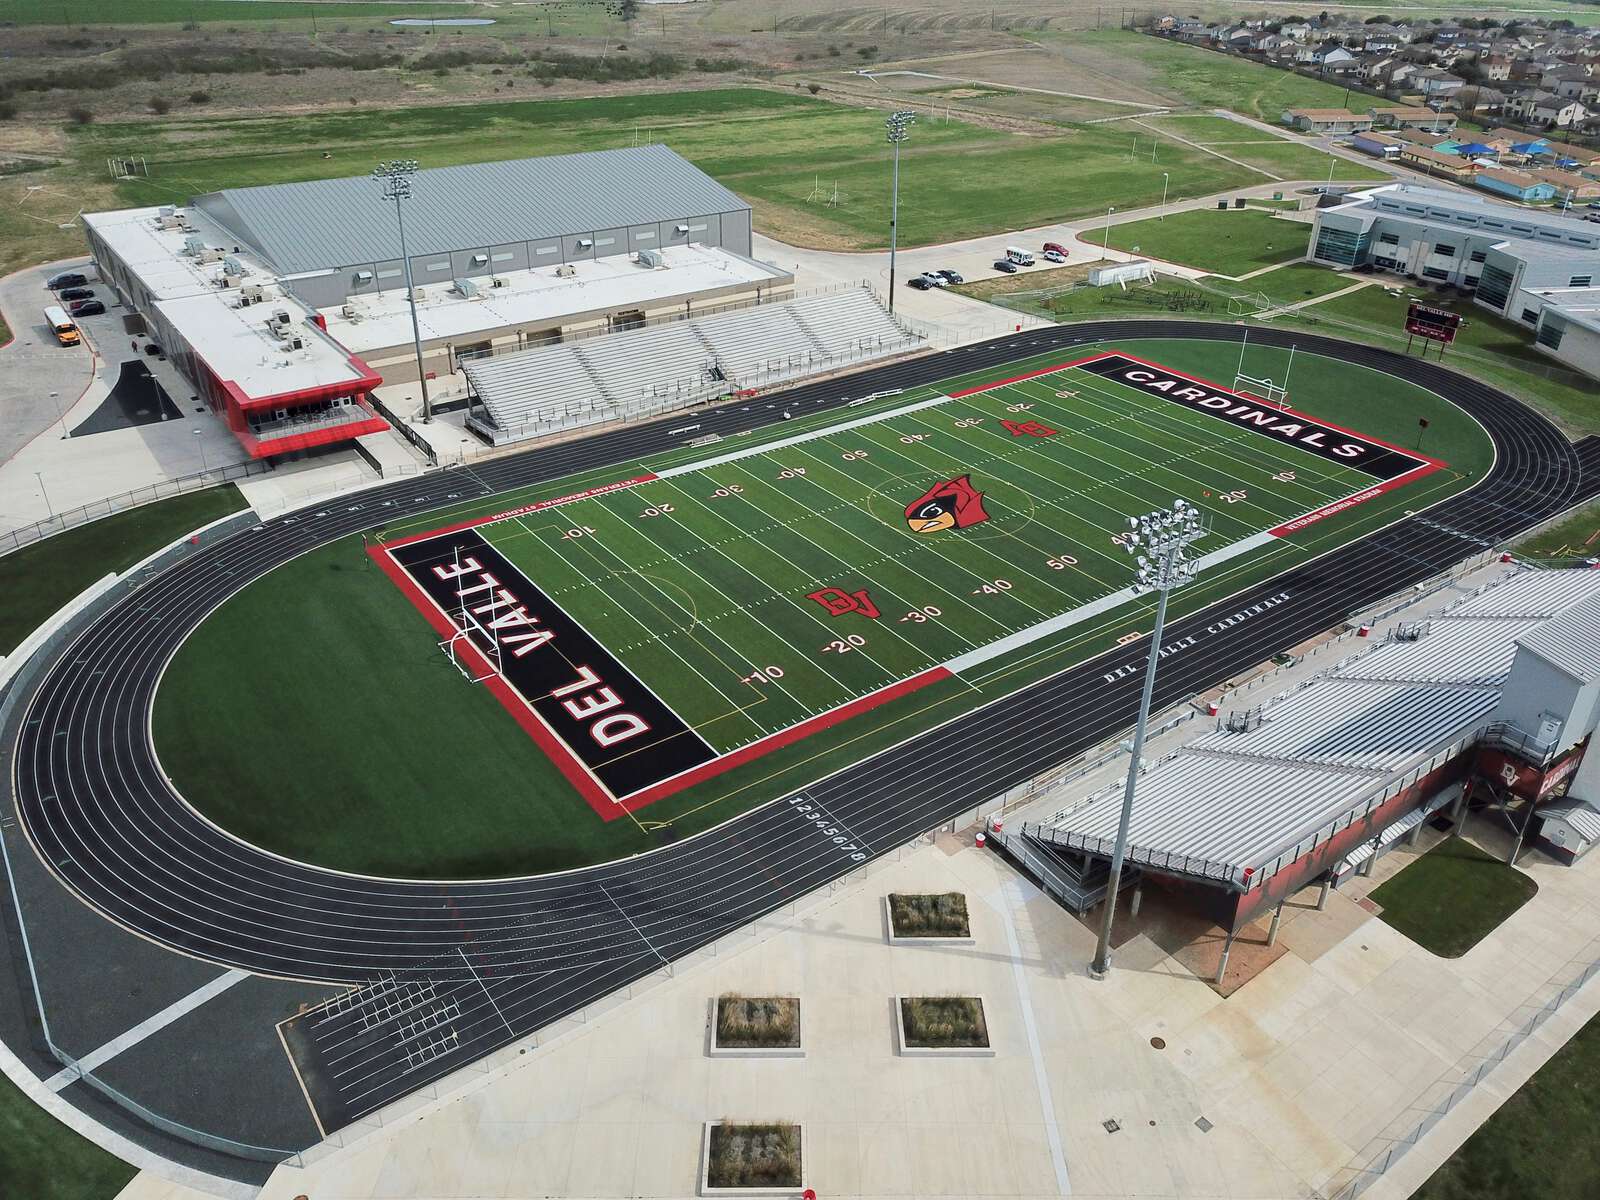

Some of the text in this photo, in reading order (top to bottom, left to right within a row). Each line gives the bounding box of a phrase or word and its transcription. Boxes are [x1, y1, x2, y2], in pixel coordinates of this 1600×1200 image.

[1006, 403, 1030, 413] 20
[1125, 370, 1366, 458] CARDINALS
[954, 418, 980, 428] 30
[900, 434, 924, 444] 40
[842, 450, 869, 461] 50
[780, 466, 807, 479] 40
[1272, 472, 1296, 483] 10
[715, 484, 744, 497] 30
[1219, 490, 1247, 503] 20
[492, 505, 536, 520] STADIUM
[645, 503, 675, 517] 20
[568, 526, 596, 538] 10
[1046, 555, 1079, 570] 50
[982, 579, 1013, 595] 40
[804, 587, 881, 619] DV
[907, 605, 942, 623] 30
[830, 634, 866, 653] 20
[1104, 592, 1290, 684] DEL ALLE CARDINALS
[432, 557, 650, 748] DEL VALLE
[750, 665, 784, 684] 10
[796, 804, 812, 813] 2
[806, 812, 821, 820] 3
[823, 828, 839, 836] 5
[850, 853, 866, 861] 8
